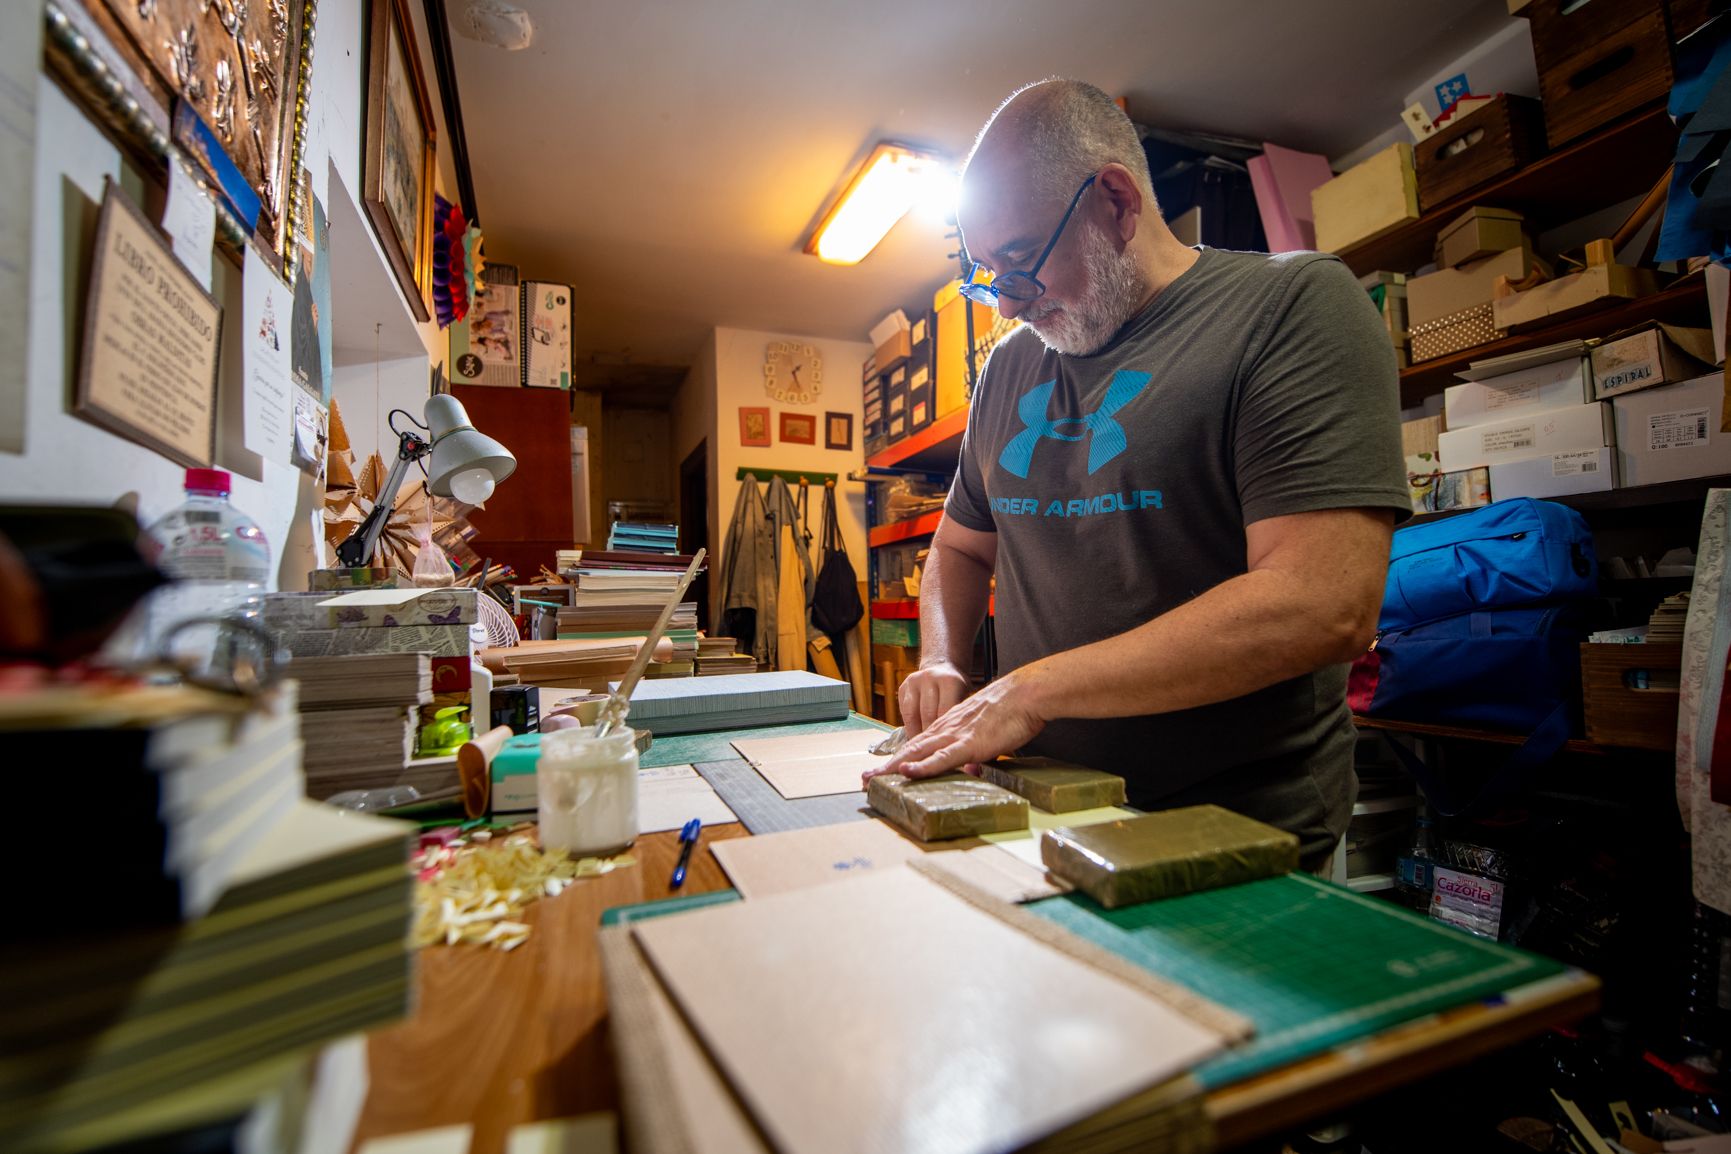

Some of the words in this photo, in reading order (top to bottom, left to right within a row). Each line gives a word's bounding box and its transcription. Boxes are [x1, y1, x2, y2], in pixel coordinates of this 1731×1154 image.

[114, 232, 156, 286] LIBRO
[1604, 366, 1651, 389] ESPIRAL
[990, 496, 1040, 516] NDER
[1044, 489, 1164, 518] ARMOUR
[1437, 877, 1491, 902] Cazorla
